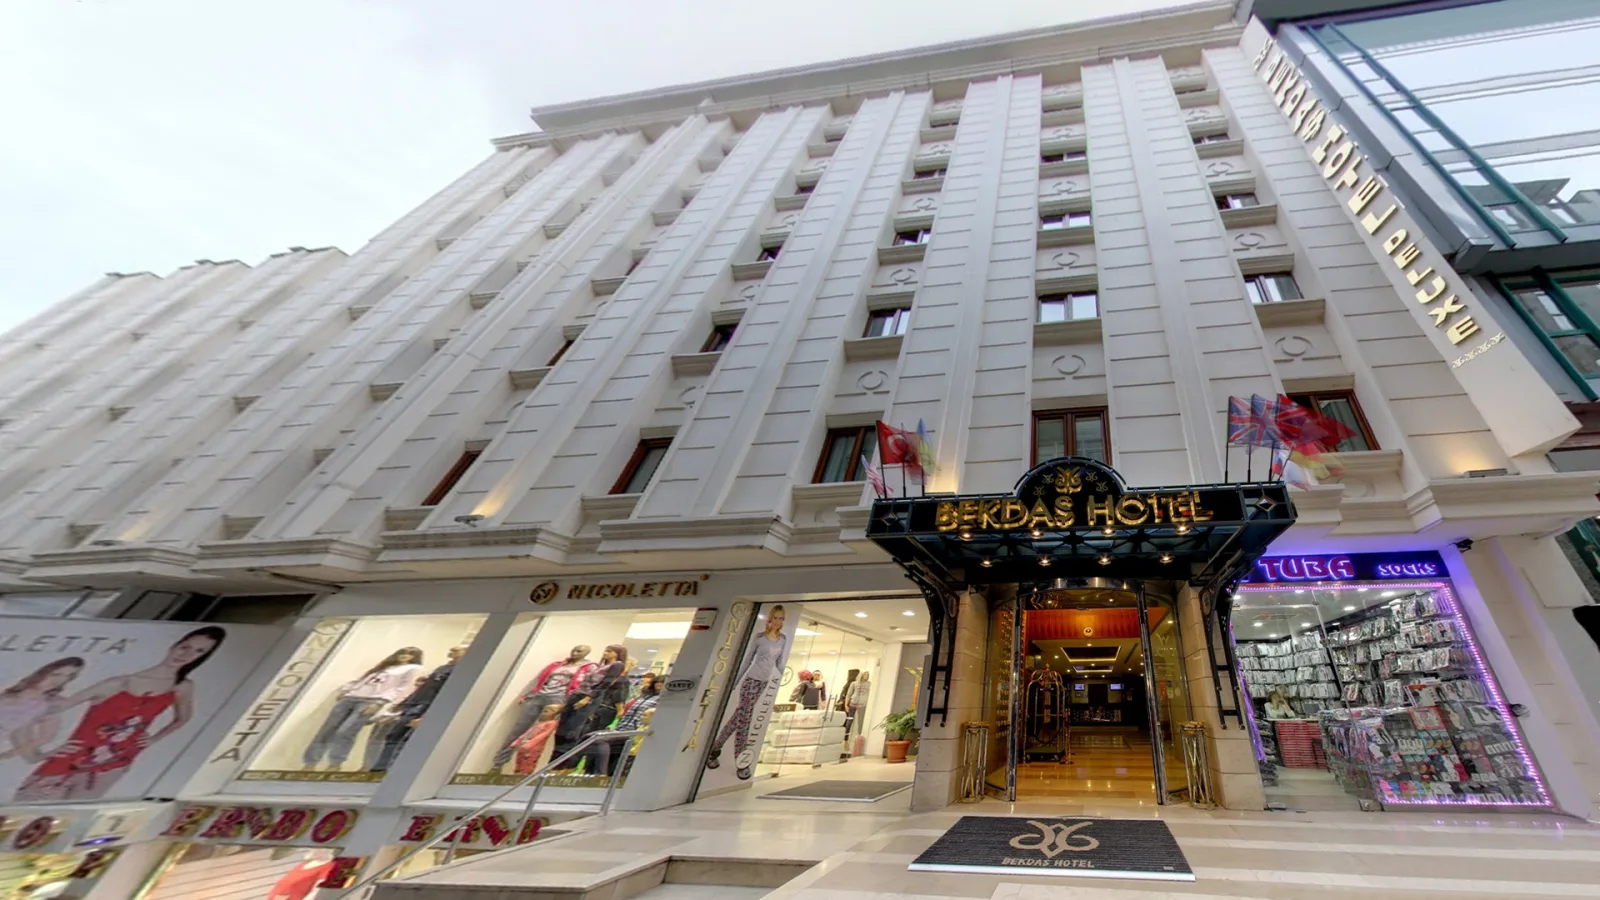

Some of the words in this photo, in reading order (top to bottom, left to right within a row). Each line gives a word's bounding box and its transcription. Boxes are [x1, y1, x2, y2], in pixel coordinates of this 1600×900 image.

[1312, 123, 1398, 236] HOTEL
[1382, 228, 1481, 345] DELUXE
[1087, 490, 1214, 527] HOTEL
[567, 580, 699, 600] NICOLETTA
[1259, 555, 1355, 580] TUBA
[1377, 562, 1438, 577] SOCKS
[210, 636, 336, 763] NICOLETTA
[681, 618, 741, 752] NICOLETTA
[746, 677, 779, 748] NICOLETTA
[1054, 859, 1095, 868] HOTEL
